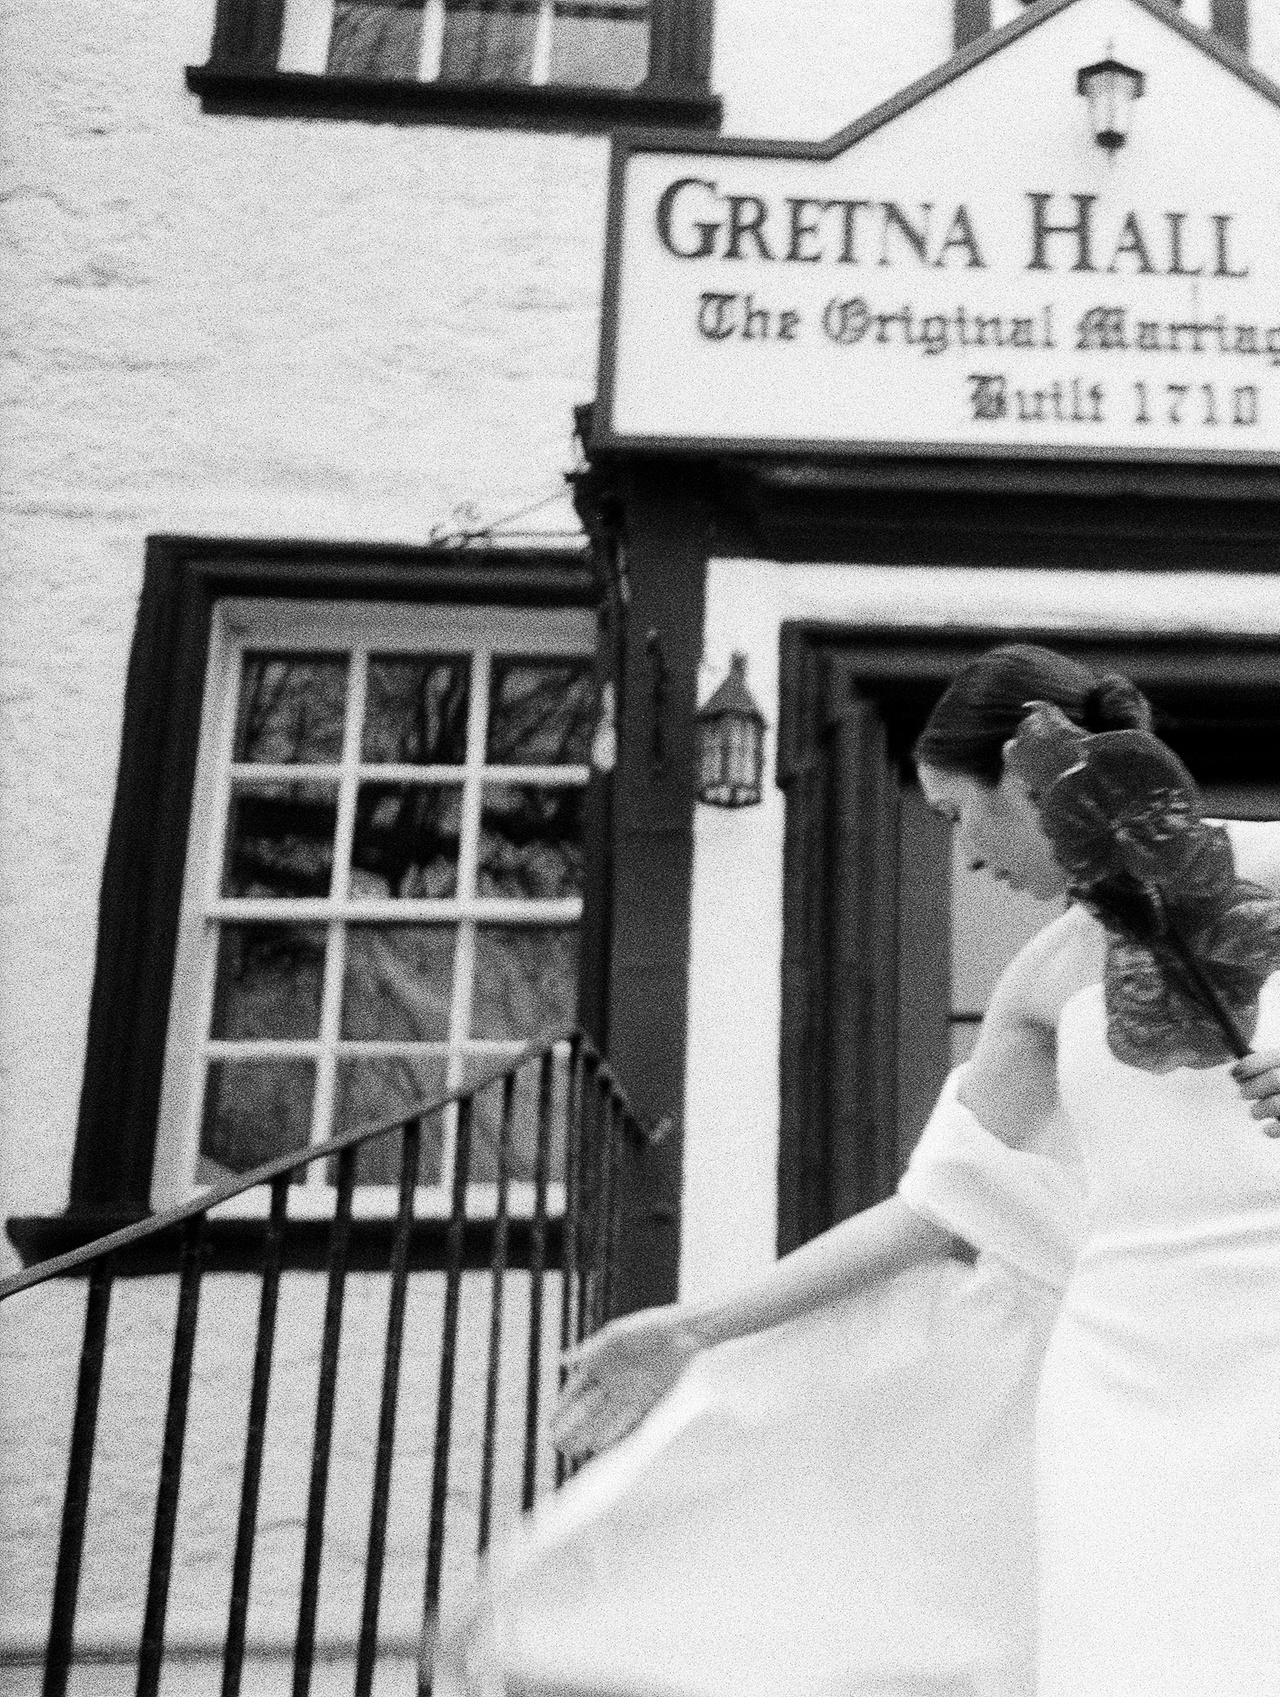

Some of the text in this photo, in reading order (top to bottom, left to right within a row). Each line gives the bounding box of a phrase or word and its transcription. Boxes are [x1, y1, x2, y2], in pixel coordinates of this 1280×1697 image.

[655, 177, 987, 269] GRETNA
[1024, 192, 1249, 278] HALL
[699, 293, 800, 340] The
[822, 298, 1055, 354] Original
[967, 373, 1259, 426] Built 1710
